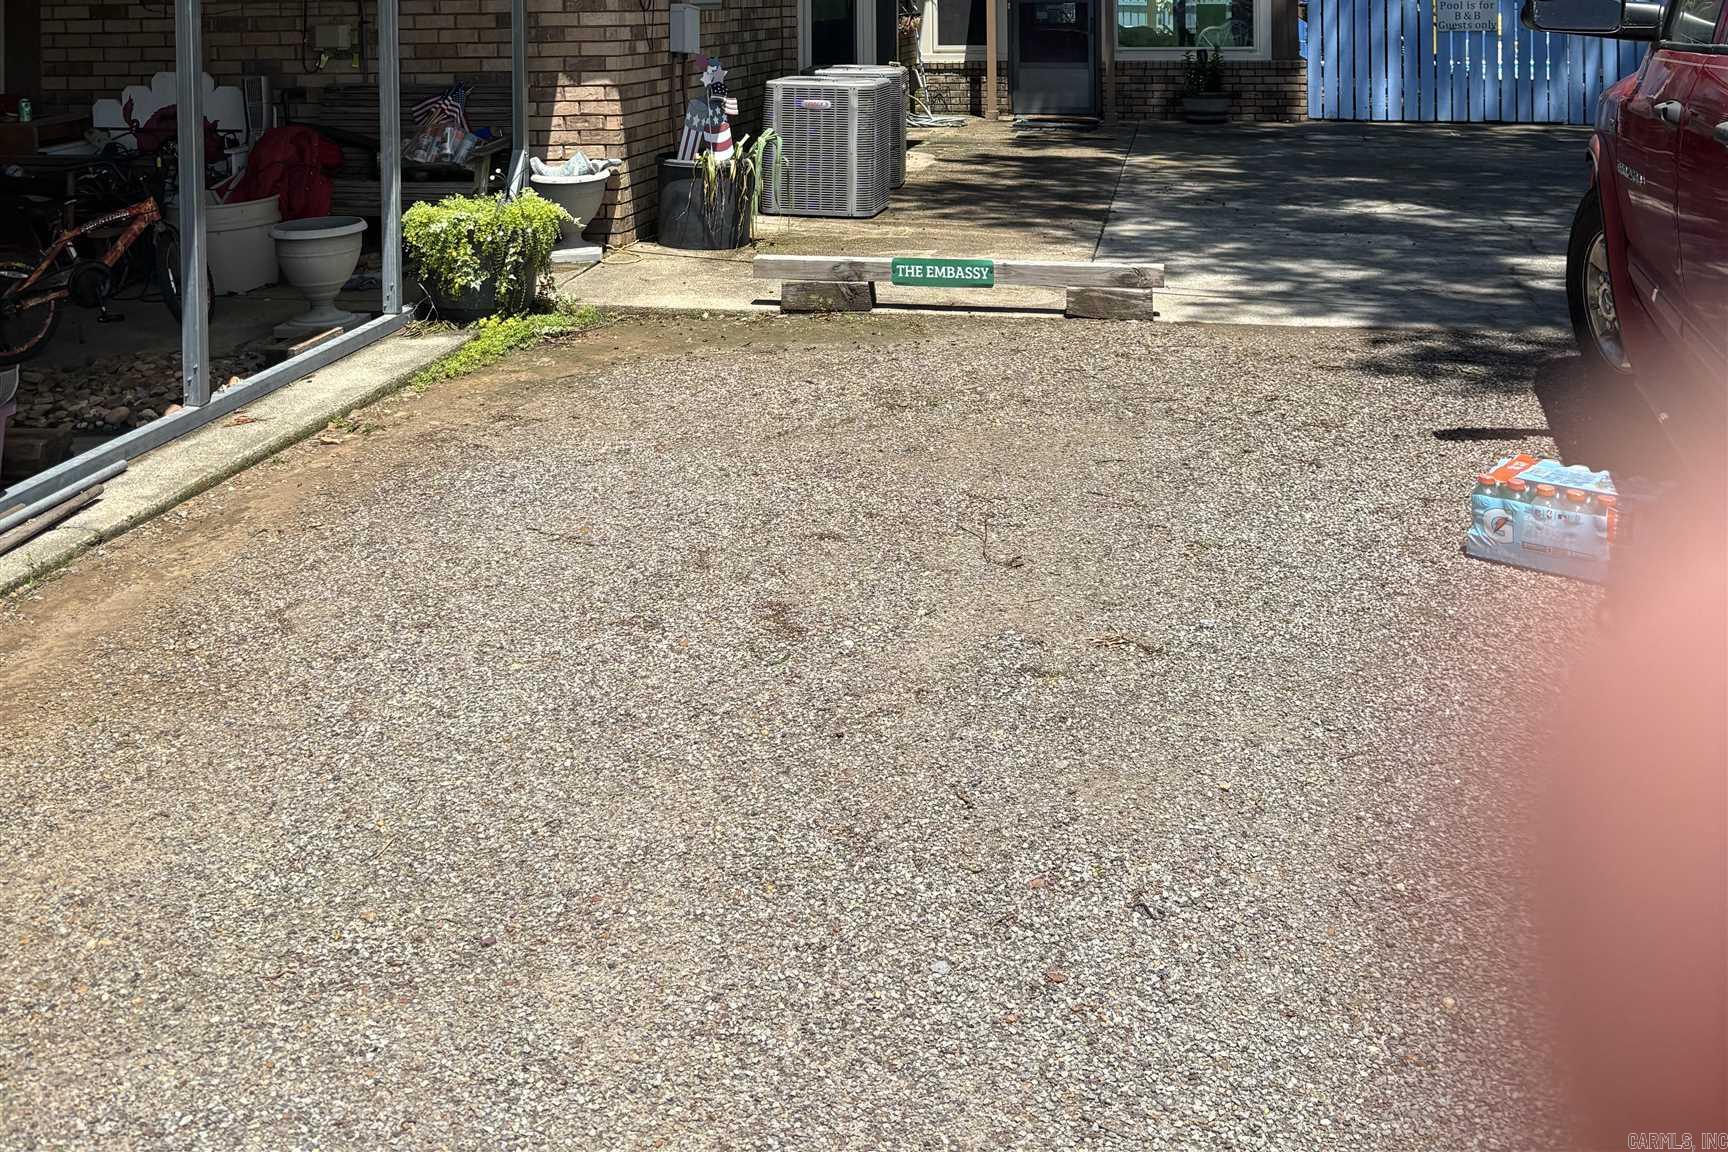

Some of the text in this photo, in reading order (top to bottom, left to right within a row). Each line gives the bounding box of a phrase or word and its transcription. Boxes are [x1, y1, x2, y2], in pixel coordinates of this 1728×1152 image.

[1440, 1, 1495, 10] Pool is for
[1455, 12, 1481, 20] B & B
[1438, 20, 1497, 30] Guests only
[896, 265, 989, 279] THE EMBASSY
